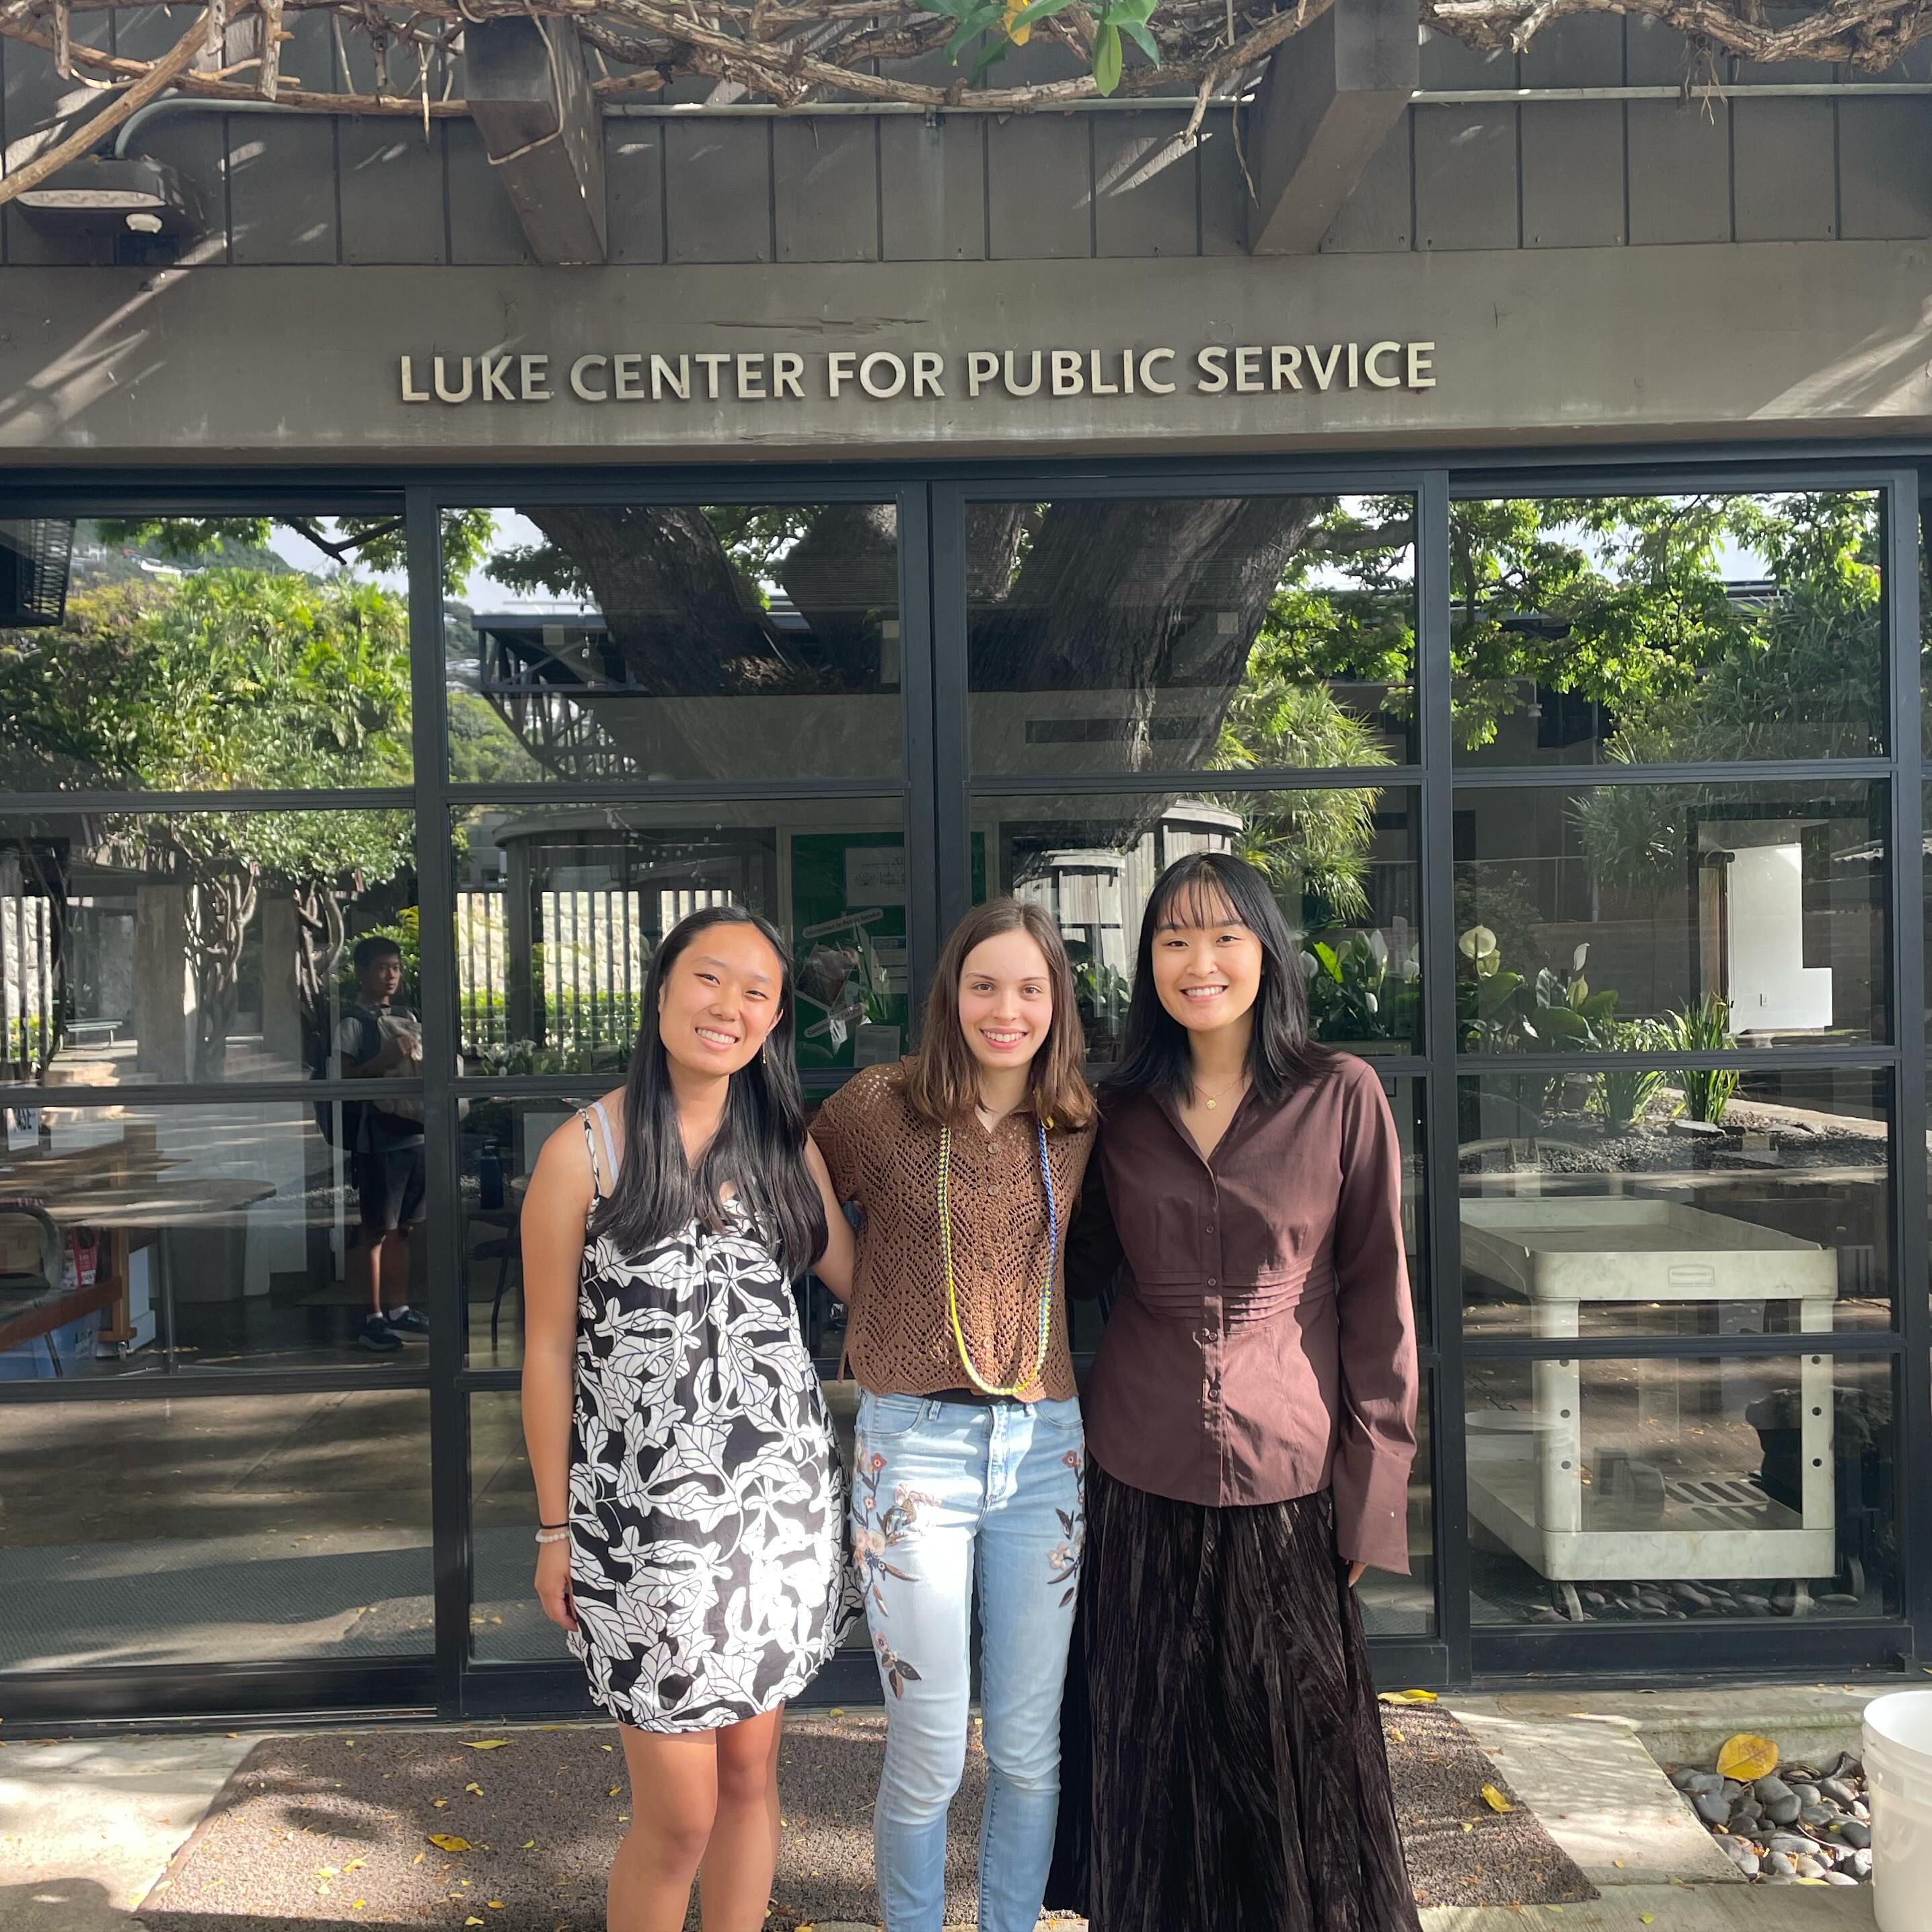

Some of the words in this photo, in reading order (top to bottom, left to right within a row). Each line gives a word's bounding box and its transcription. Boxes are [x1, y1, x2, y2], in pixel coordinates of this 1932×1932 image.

[401, 355, 549, 402] LUKE
[570, 352, 806, 401] CENTER
[828, 351, 946, 399] FOR
[967, 348, 1176, 397] PUBLIC
[1197, 341, 1437, 392] SERVICE
